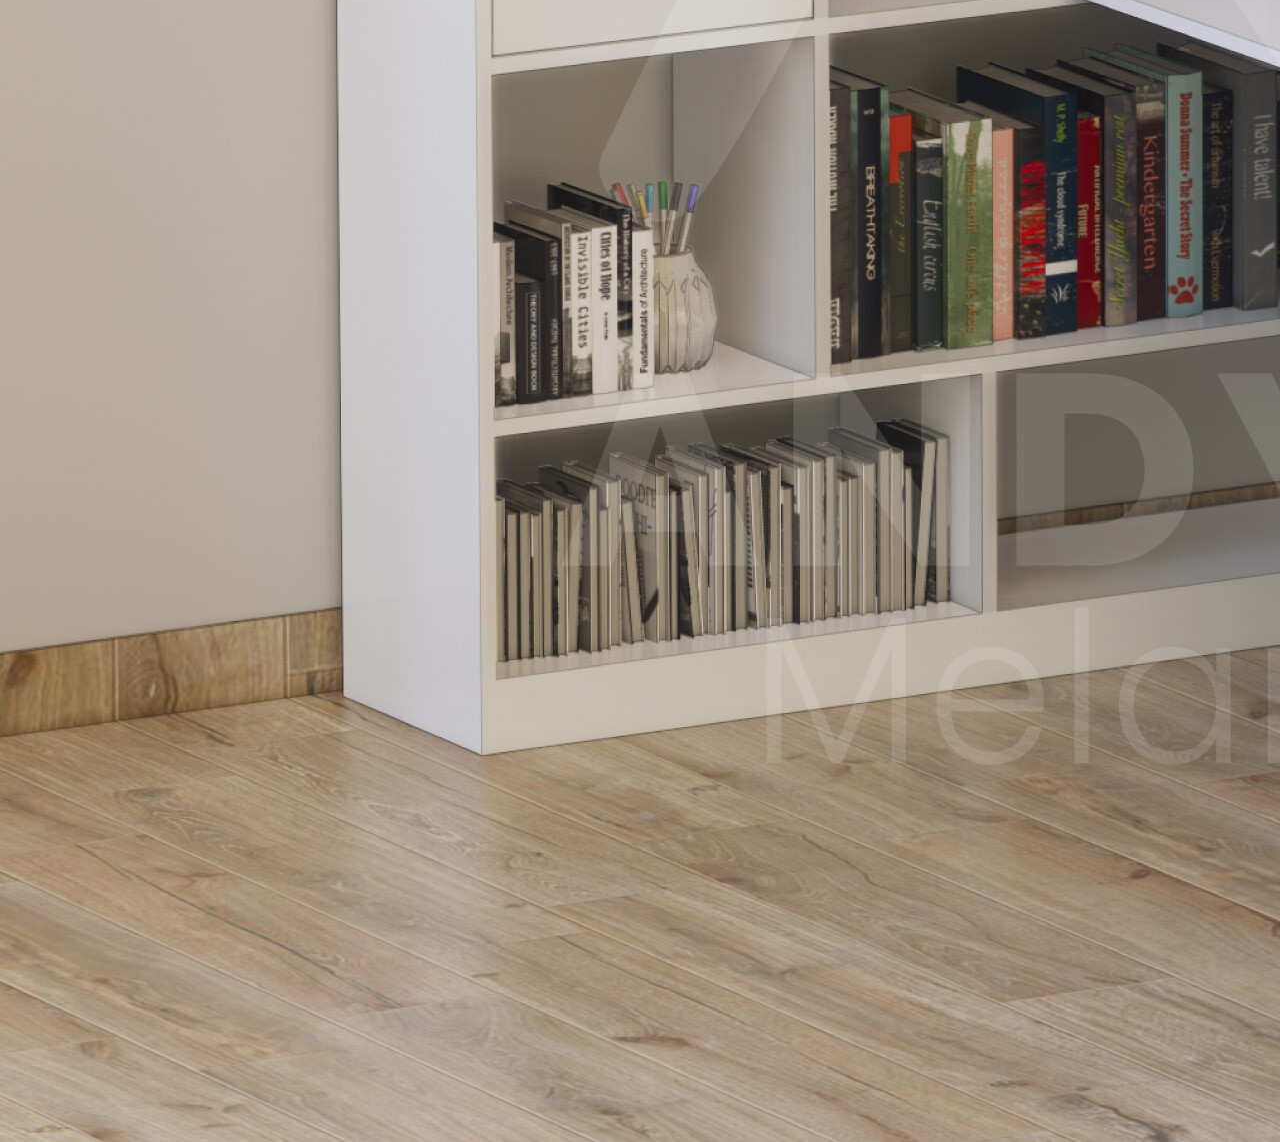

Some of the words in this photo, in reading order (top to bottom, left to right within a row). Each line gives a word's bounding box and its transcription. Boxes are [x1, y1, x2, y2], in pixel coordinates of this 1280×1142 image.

[1180, 92, 1193, 126] Donna
[1210, 101, 1222, 118] The
[1210, 120, 1221, 134] art
[1210, 136, 1222, 146] of
[1254, 122, 1275, 156] have
[966, 132, 978, 159] Save
[1180, 128, 1193, 172] Summer
[966, 162, 978, 197] Planet
[1056, 170, 1068, 186] The
[1111, 147, 1132, 207] premium
[1180, 178, 1193, 198] The
[1254, 158, 1275, 200] talent!
[1056, 186, 1068, 208] cloud
[1138, 135, 1160, 270] Kindergarten
[865, 166, 876, 282] BREATHTAKING
[916, 199, 942, 251] English
[966, 200, 979, 234] Earth!
[1180, 200, 1193, 232] Secret
[600, 232, 612, 259] Cities
[966, 246, 978, 271] One
[1176, 233, 1193, 260] Story
[578, 236, 589, 300] Invisible
[600, 261, 612, 272] of
[640, 248, 648, 298] Architecture
[922, 252, 937, 292] circus
[504, 277, 513, 326] Architecture
[598, 274, 612, 301] Hope
[966, 274, 979, 299] safe
[1106, 266, 1126, 312] Secret
[530, 294, 538, 322] THEORY
[640, 300, 648, 308] of
[964, 301, 979, 334] place
[530, 324, 538, 340] AND
[578, 306, 589, 349] Cities
[640, 311, 648, 374] Fundamentals
[530, 342, 538, 369] DESIGN
[530, 370, 538, 392] BOOK
